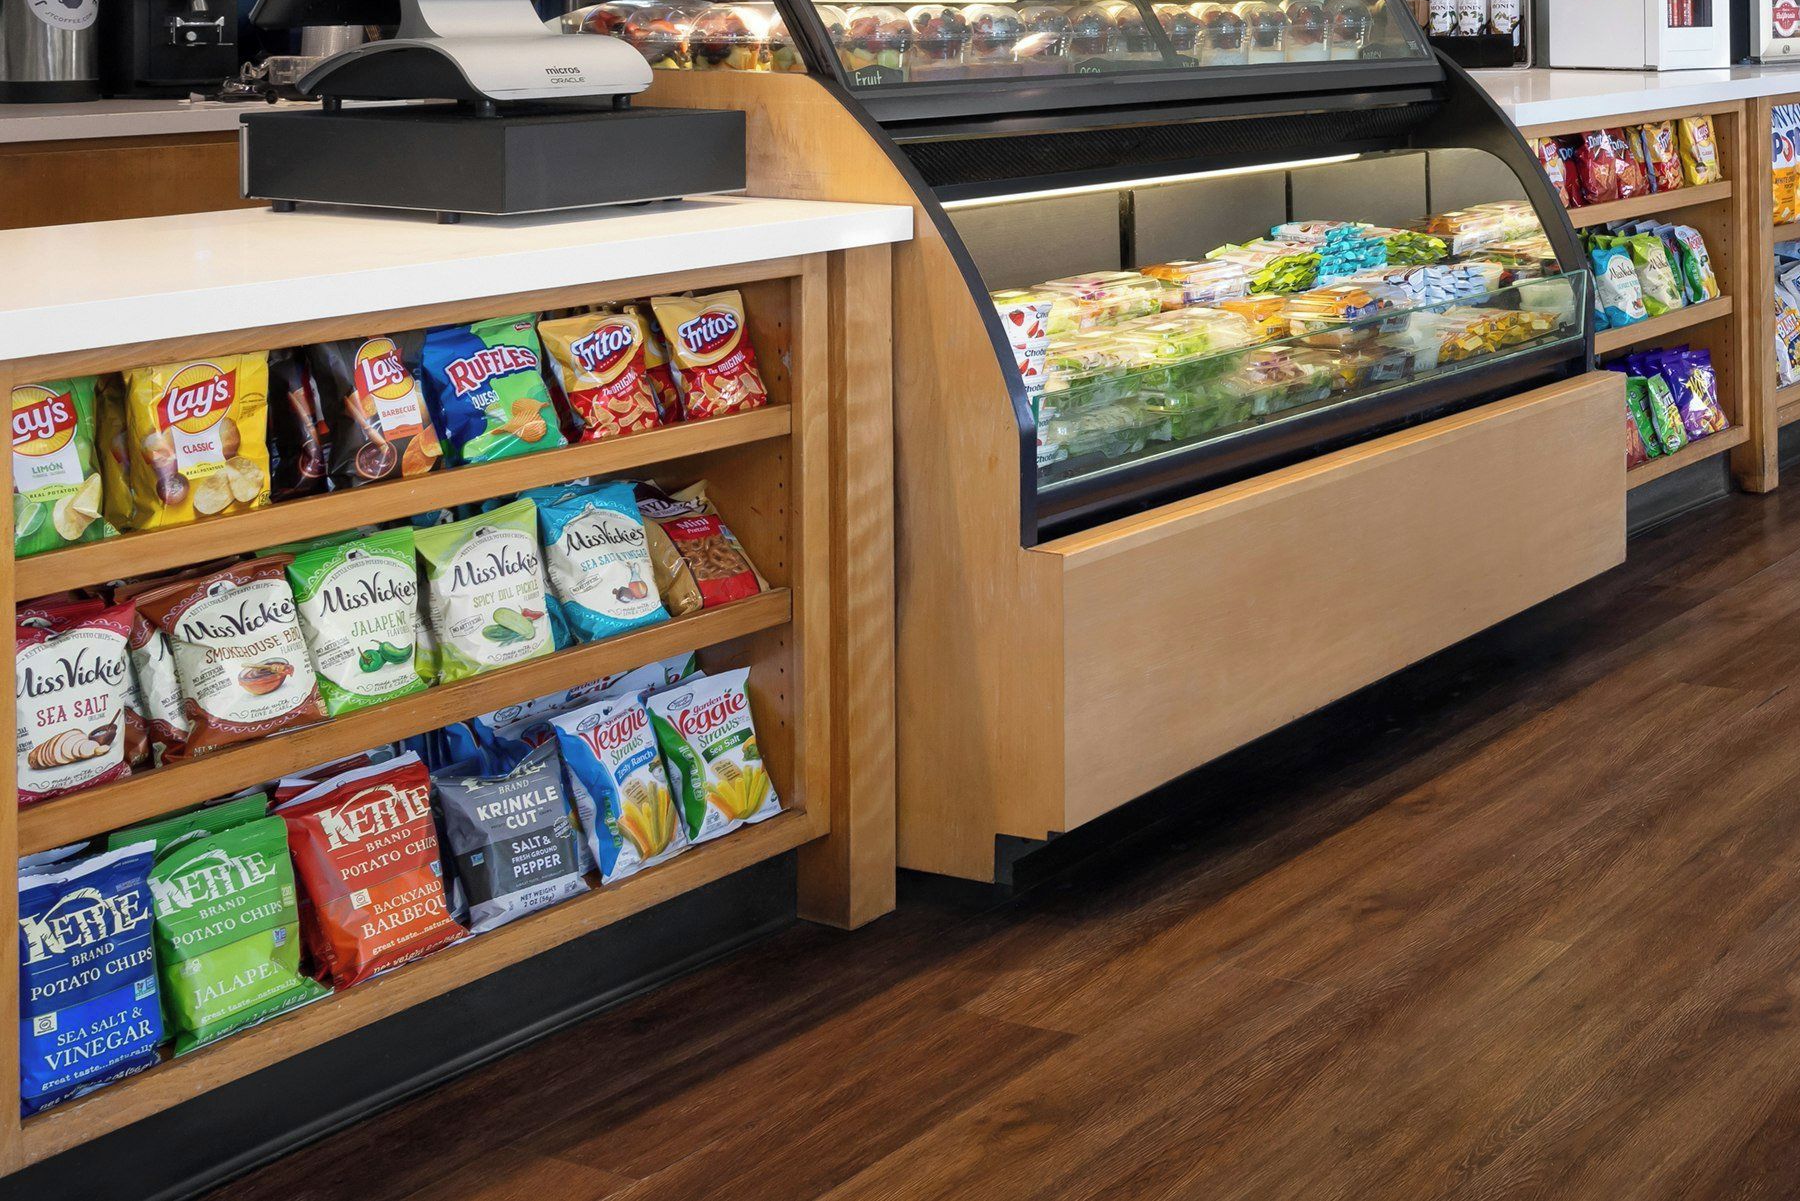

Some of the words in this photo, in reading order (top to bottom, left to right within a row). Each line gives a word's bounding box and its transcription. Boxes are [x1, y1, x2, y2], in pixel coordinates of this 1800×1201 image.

[545, 66, 581, 75] micros
[678, 310, 739, 353] Fritos
[571, 324, 633, 371] Fritos
[361, 351, 403, 391] Lay's
[447, 346, 537, 394] RUFFLES
[13, 397, 70, 432] ay's
[167, 377, 230, 423] Lay's
[382, 404, 417, 418] BARBECUE
[472, 390, 500, 411] QUESO
[183, 440, 215, 455] CLASSIC
[30, 488, 46, 500] REAL
[47, 485, 79, 498] POTATOES
[676, 517, 709, 530] Mini
[687, 526, 711, 534] Pretzels
[581, 559, 598, 573] SEA
[600, 553, 618, 566] SALT
[474, 591, 496, 609] SPICY
[517, 579, 540, 596] PICKLE
[206, 635, 282, 664] SMOKEHOUSE
[37, 704, 68, 728] SEA
[74, 693, 109, 718] SALT
[667, 691, 748, 740] Veggie
[692, 695, 723, 716] garden
[579, 706, 650, 761] Veggie
[697, 718, 740, 749] Straws
[709, 744, 723, 756] Sea
[724, 735, 741, 748] Salt
[610, 734, 644, 766] Straws
[617, 761, 632, 780] Zesty
[631, 750, 655, 767] Ranch
[499, 779, 530, 795] BRAND
[313, 784, 432, 853] KETTLE
[476, 785, 559, 822] KRINKLE
[506, 809, 538, 830] CUT
[366, 828, 412, 853] BRAND
[512, 835, 541, 854] SALT
[542, 835, 552, 845] &
[512, 852, 531, 864] FRESH
[531, 845, 558, 859] GROUND
[340, 850, 401, 881] POTATO
[405, 835, 438, 856] CHIPS
[513, 853, 562, 878] PEPPER
[147, 849, 277, 920] KETTLE
[373, 880, 442, 916] BACKYARD
[520, 892, 533, 902] NET
[533, 884, 558, 898] WEIGHT
[198, 895, 246, 920] BRAND
[361, 894, 447, 940] BARBEQU
[18, 887, 150, 966] KETTLE
[172, 918, 236, 950] POTATO
[240, 900, 283, 925] CHIPS
[71, 942, 115, 967] BRAND
[31, 968, 101, 1001] POTATO
[105, 946, 153, 975] CHIPS
[57, 1029, 88, 1047] SEA
[91, 1011, 128, 1035] SALT
[131, 1006, 144, 1019] &
[44, 1019, 154, 1072] VINEGAR
[41, 1073, 71, 1092] great
